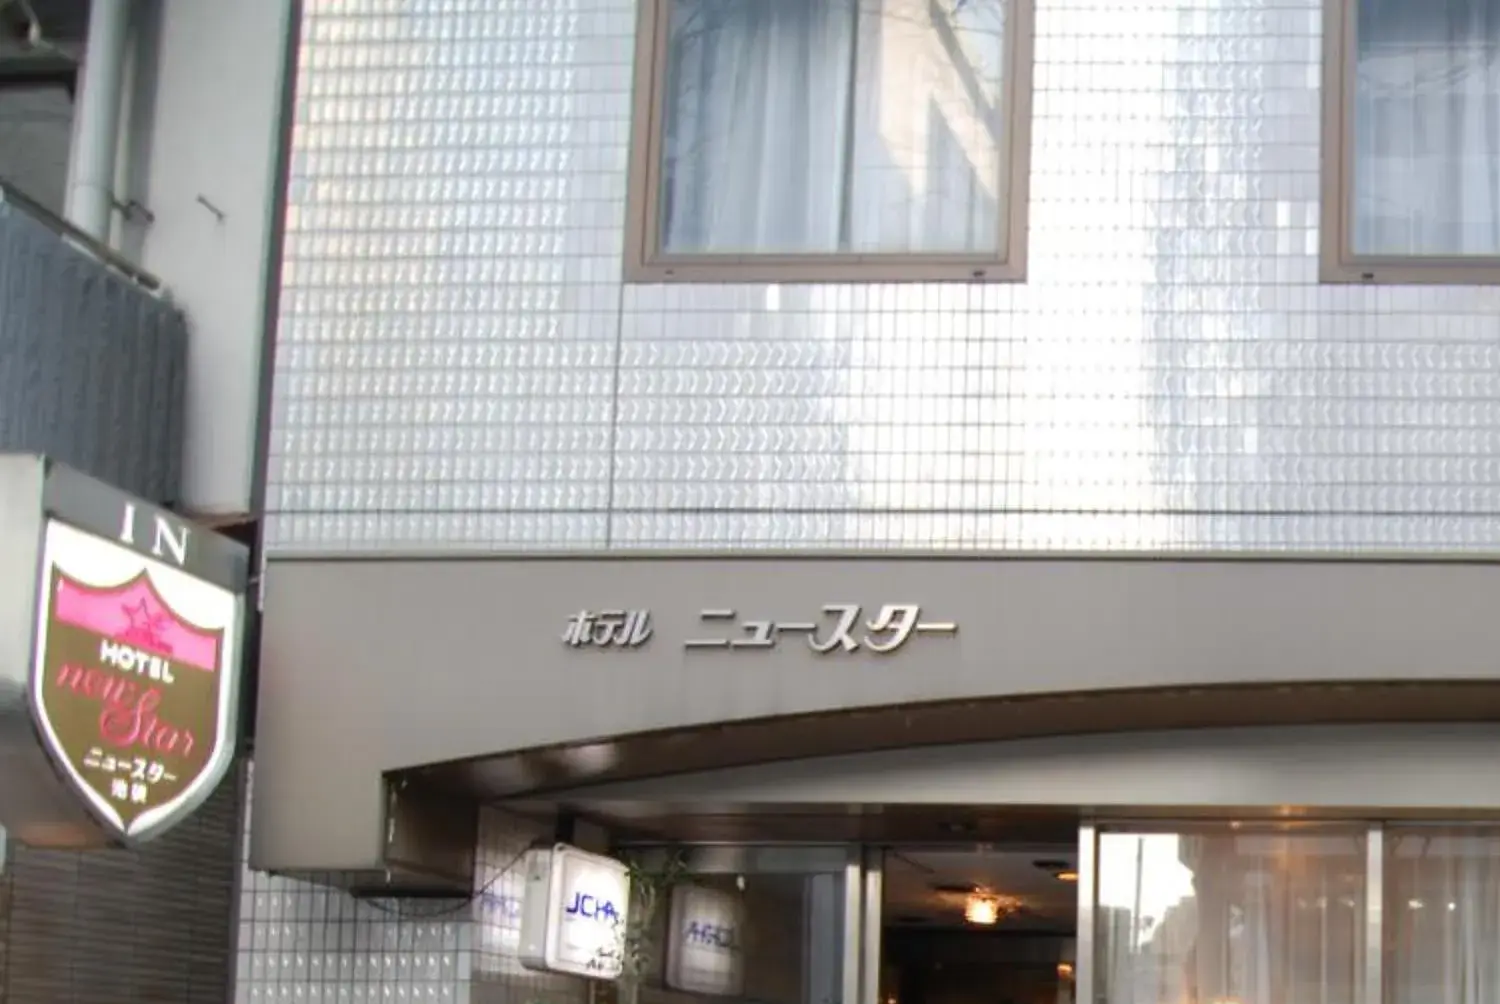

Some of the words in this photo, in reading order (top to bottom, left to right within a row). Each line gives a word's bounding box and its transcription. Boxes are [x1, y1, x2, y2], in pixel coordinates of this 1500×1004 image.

[119, 502, 190, 566] IN
[561, 609, 653, 646] ホテル
[684, 604, 958, 652] ニュースター
[100, 639, 175, 684] HOTEL
[83, 747, 178, 784] ニュースター
